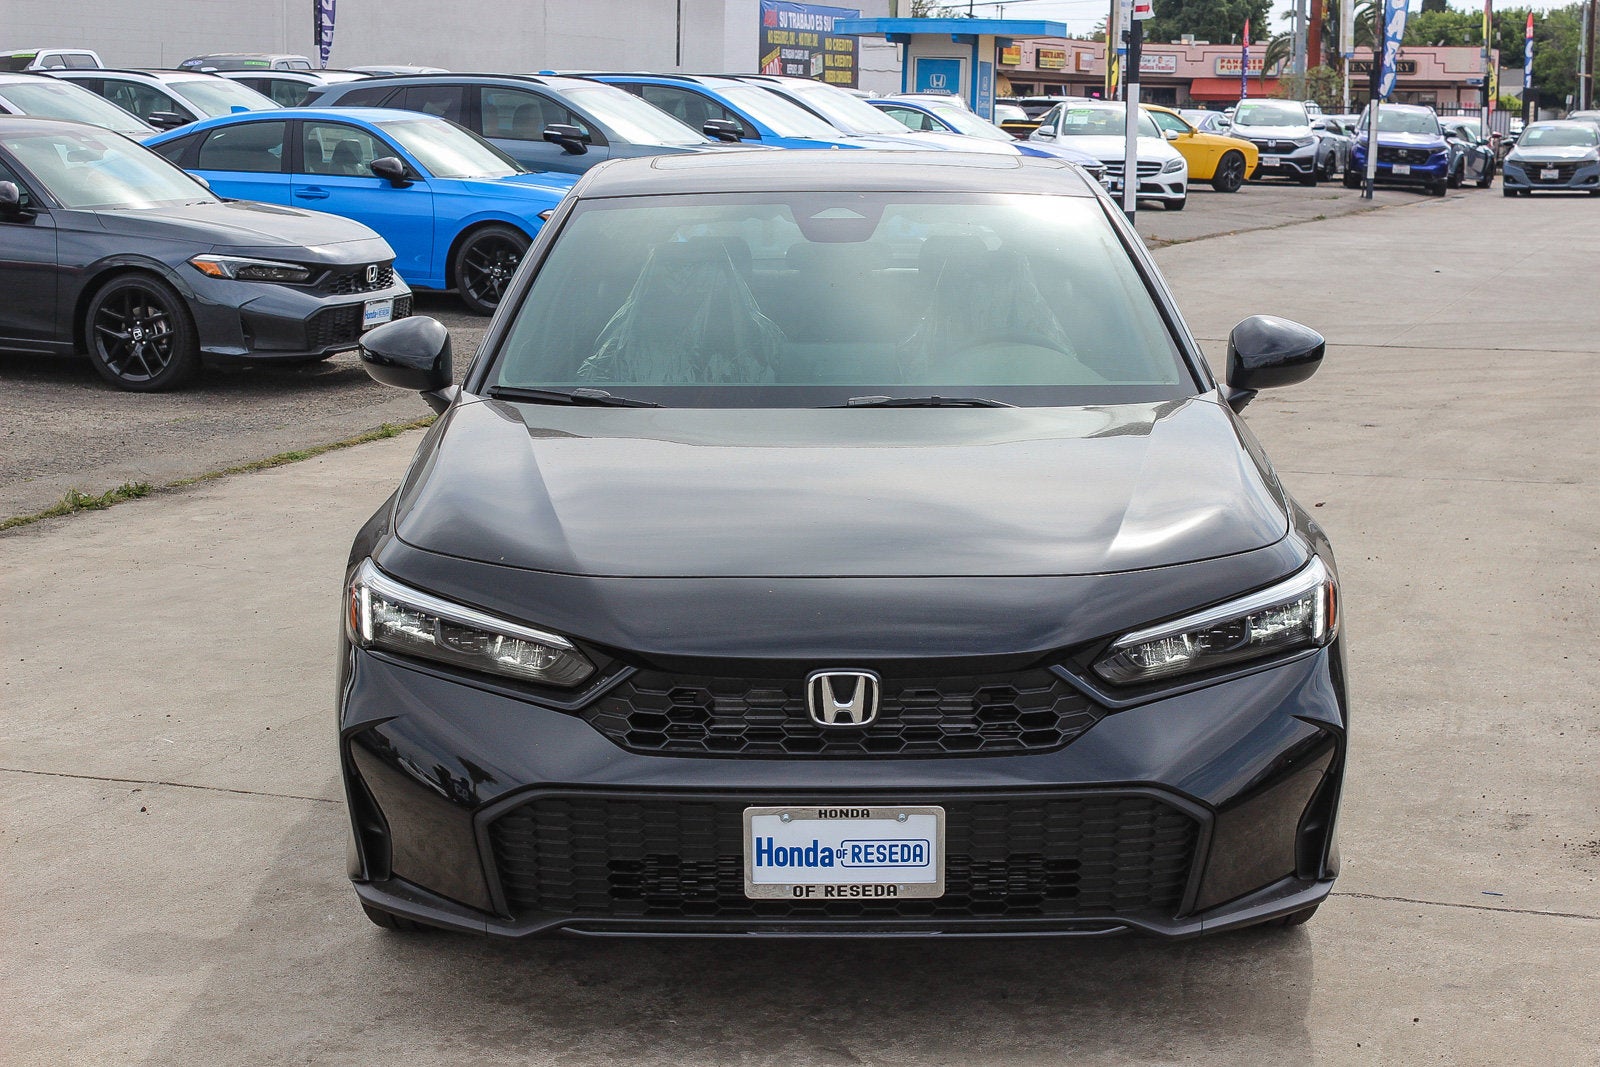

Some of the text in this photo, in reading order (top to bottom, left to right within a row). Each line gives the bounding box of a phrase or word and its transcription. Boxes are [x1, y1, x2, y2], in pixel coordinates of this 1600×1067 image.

[780, 11, 787, 27] SU
[816, 15, 823, 31] ES
[824, 16, 831, 31] SU
[818, 809, 870, 818] HONDA
[756, 837, 924, 867] Honda OF RESEDA
[793, 885, 898, 897] OF RESEDA
